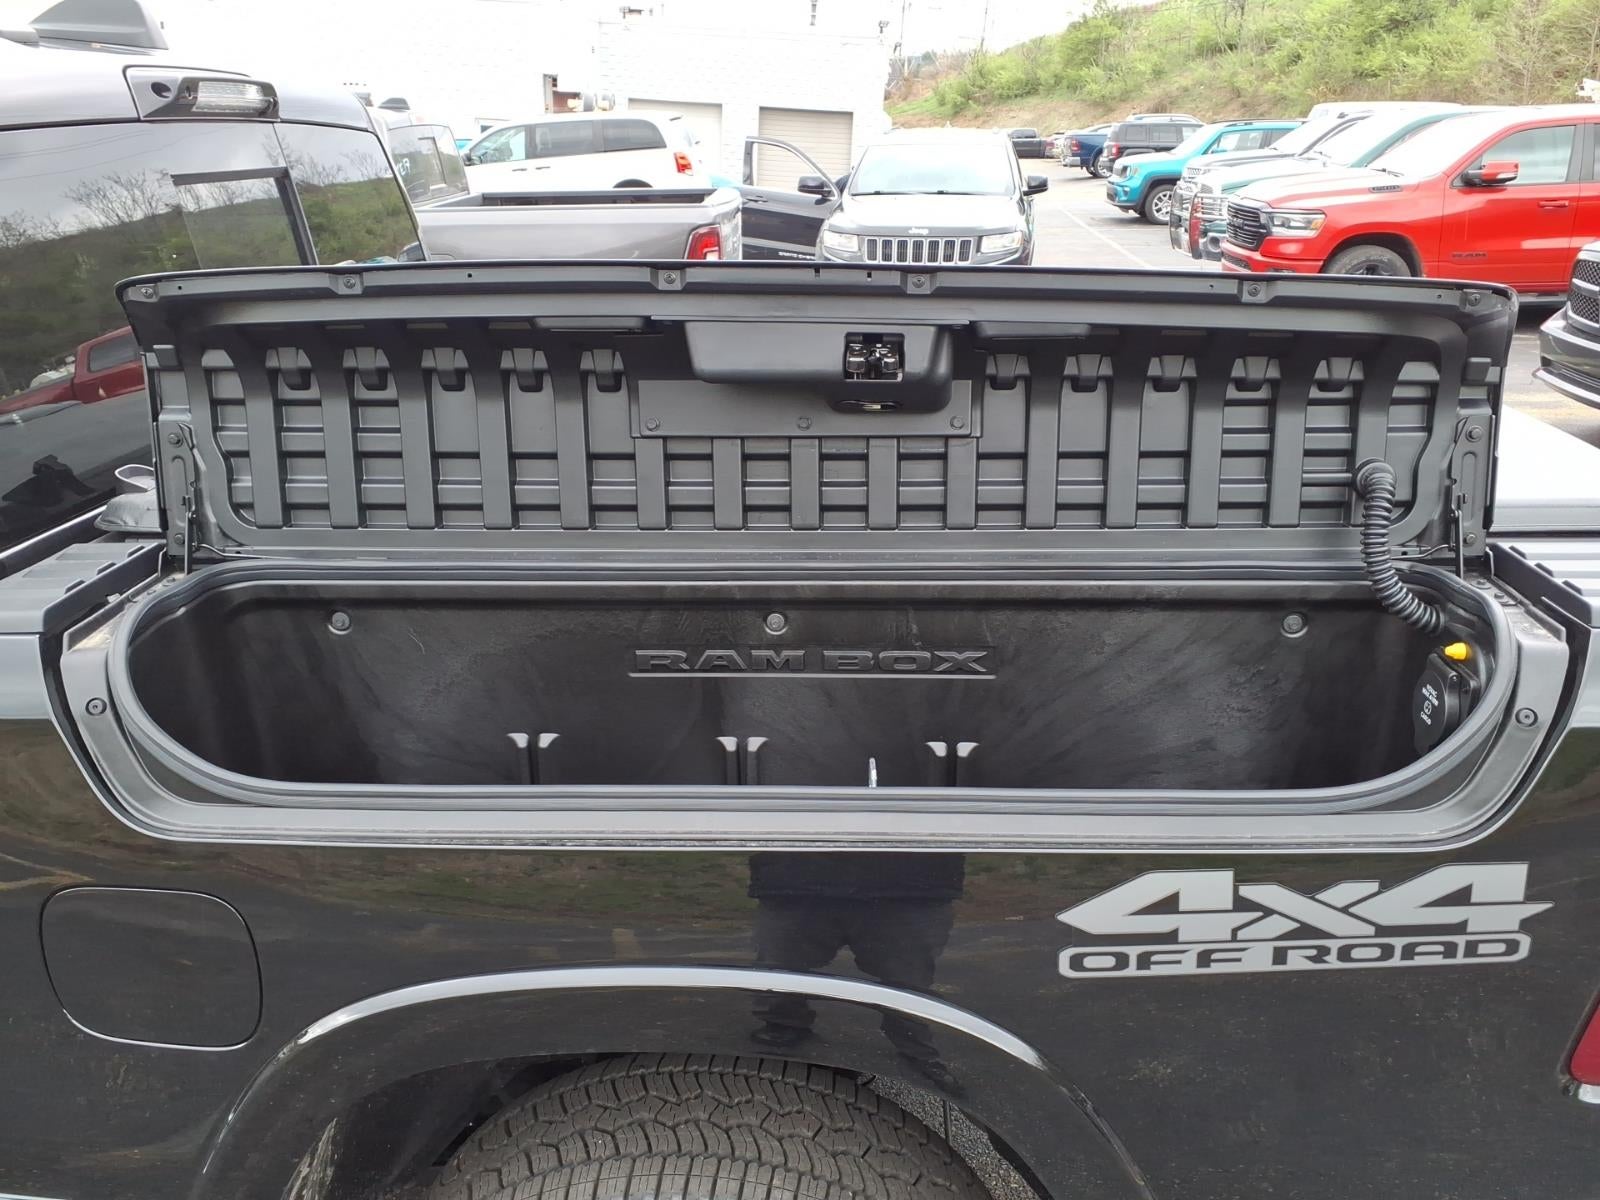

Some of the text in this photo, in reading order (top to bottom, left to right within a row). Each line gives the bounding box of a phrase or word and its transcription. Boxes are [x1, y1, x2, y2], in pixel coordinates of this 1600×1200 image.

[635, 649, 988, 672] RAM BOX
[1068, 938, 1520, 973] OFF ROAD
